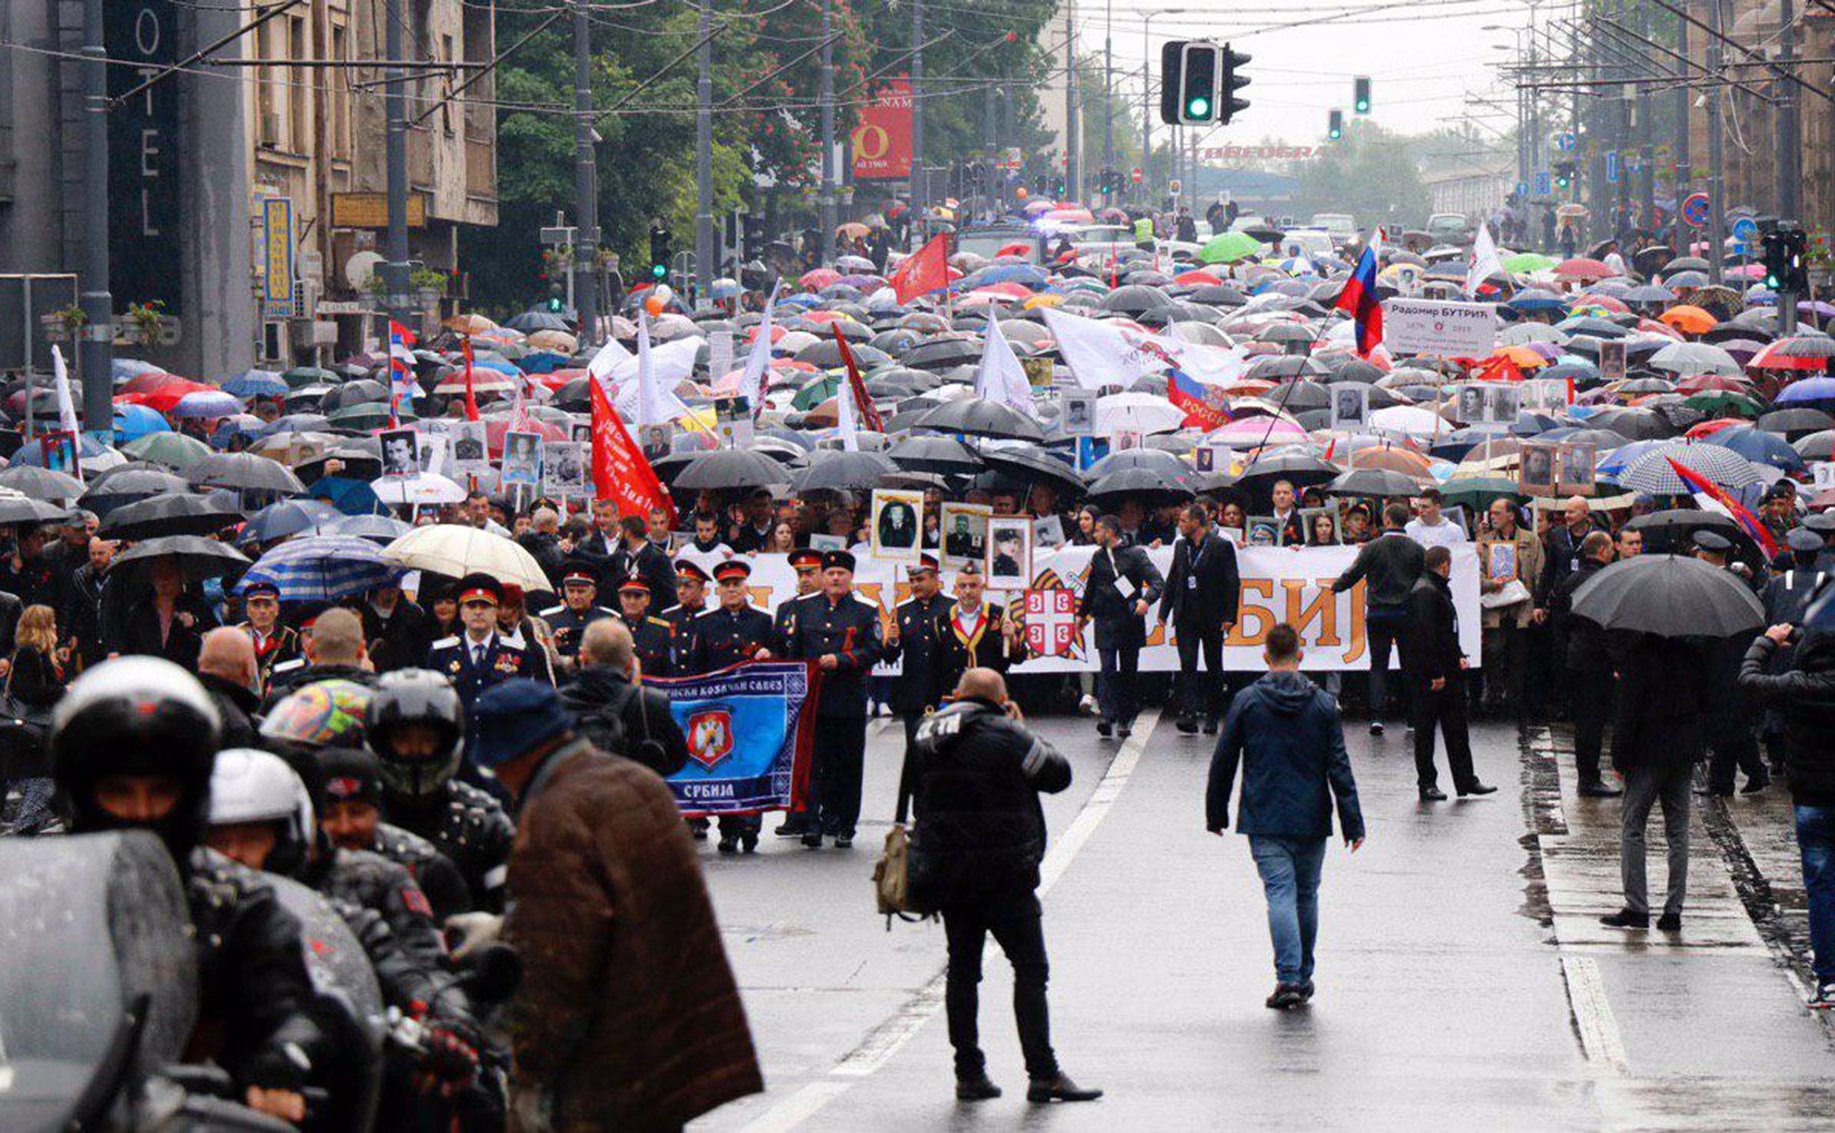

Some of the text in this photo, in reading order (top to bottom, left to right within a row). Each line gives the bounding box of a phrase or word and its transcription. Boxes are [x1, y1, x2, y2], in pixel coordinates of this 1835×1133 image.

[1391, 304, 1489, 319] Радомир БУТРИЋ
[749, 680, 784, 692] САВЕЗ
[684, 783, 735, 798] СРБИЈА
